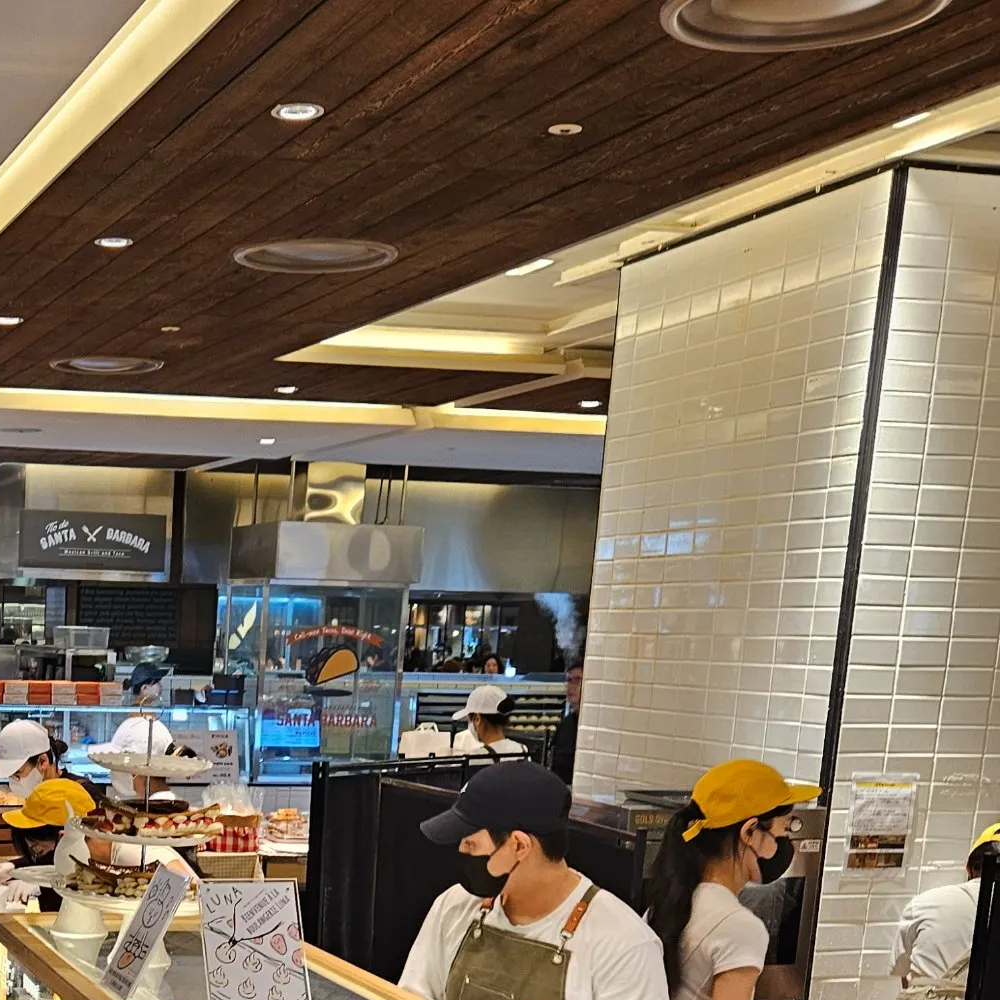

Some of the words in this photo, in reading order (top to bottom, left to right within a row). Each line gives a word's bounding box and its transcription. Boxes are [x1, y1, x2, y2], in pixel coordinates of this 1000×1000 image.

[40, 528, 77, 550] SANTA
[106, 527, 151, 554] BARBARA
[277, 713, 316, 726] SANTA
[321, 713, 377, 728] BARBARA
[206, 886, 243, 914] LUNA
